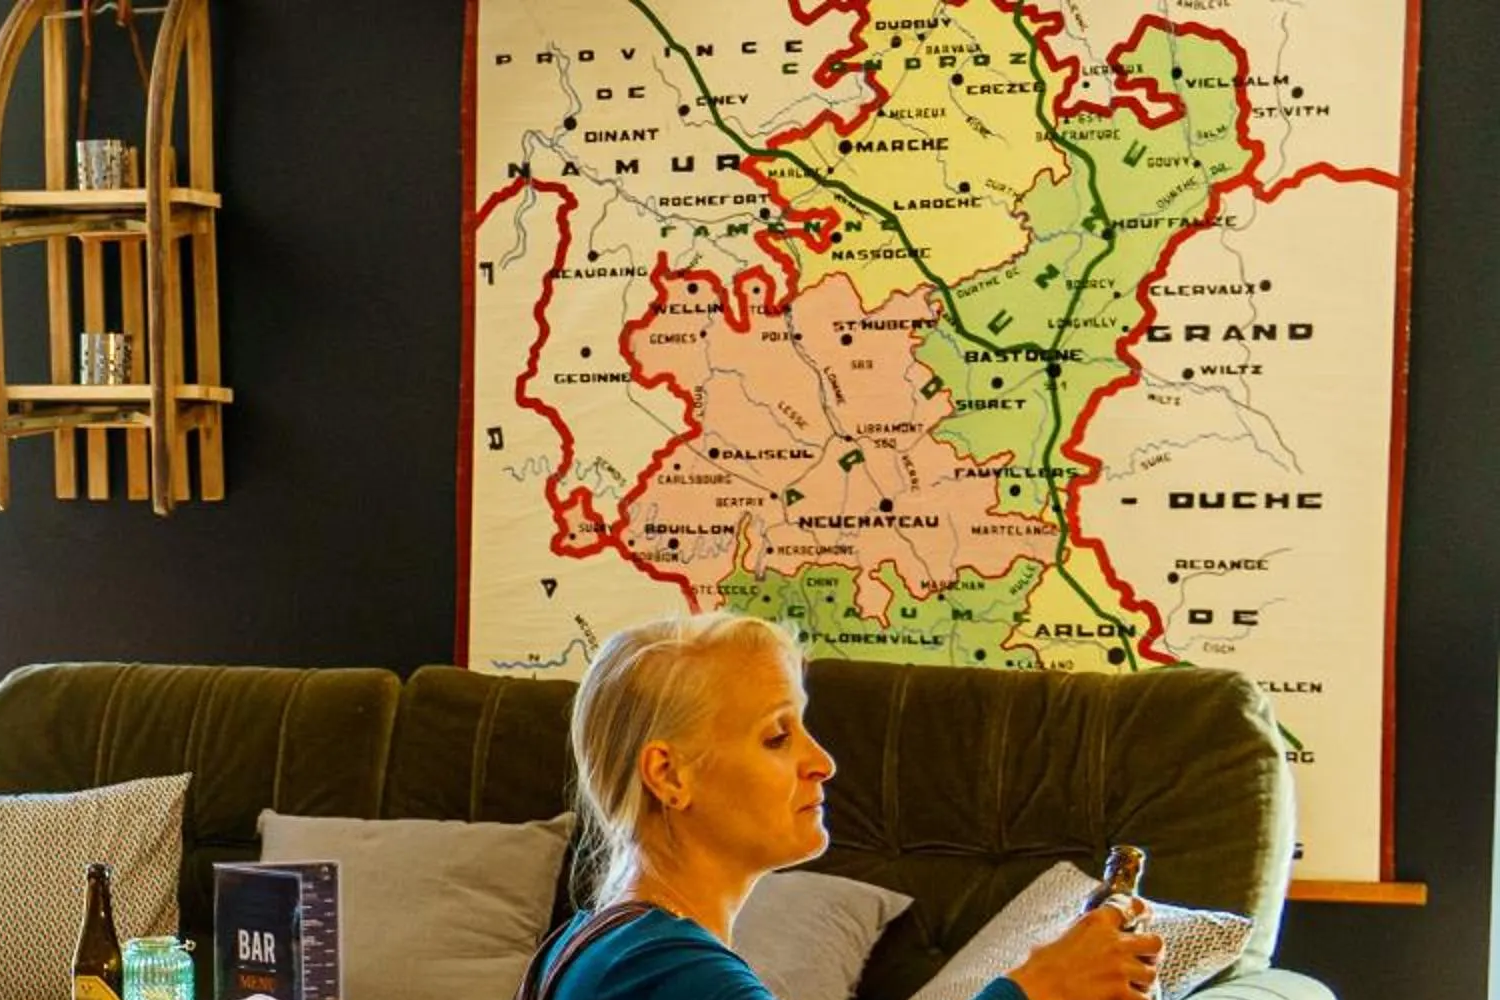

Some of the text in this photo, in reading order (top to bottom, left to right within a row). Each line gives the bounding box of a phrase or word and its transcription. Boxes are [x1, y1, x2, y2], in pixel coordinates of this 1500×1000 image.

[875, 18, 952, 31] DURBUY
[1186, 75, 1289, 88] VIELSALM
[596, 86, 646, 101] DE
[585, 128, 660, 143] DINANT
[856, 138, 949, 153] MARCHE
[508, 154, 741, 178] NAMUR
[659, 193, 770, 207] ROCHEFORT
[893, 197, 983, 211] LAROCHE
[1150, 284, 1256, 296] CLERVAUX
[653, 303, 725, 315] WELLIN
[1147, 324, 1314, 342] GRAND
[964, 348, 1085, 363] BASTOGNE
[1200, 365, 1264, 376] WILTZ
[554, 372, 632, 384] GEDINNE
[956, 399, 1027, 411] SIBRET
[856, 423, 925, 435] LIBRAMONT
[1168, 491, 1324, 509] DUCHE
[644, 524, 735, 535] BOUILLON
[1175, 559, 1269, 571] REDANGE
[1188, 609, 1258, 626] DE
[1035, 624, 1137, 638] ARLON
[812, 632, 944, 646] FLORENVILLE
[238, 928, 276, 964] BAR
